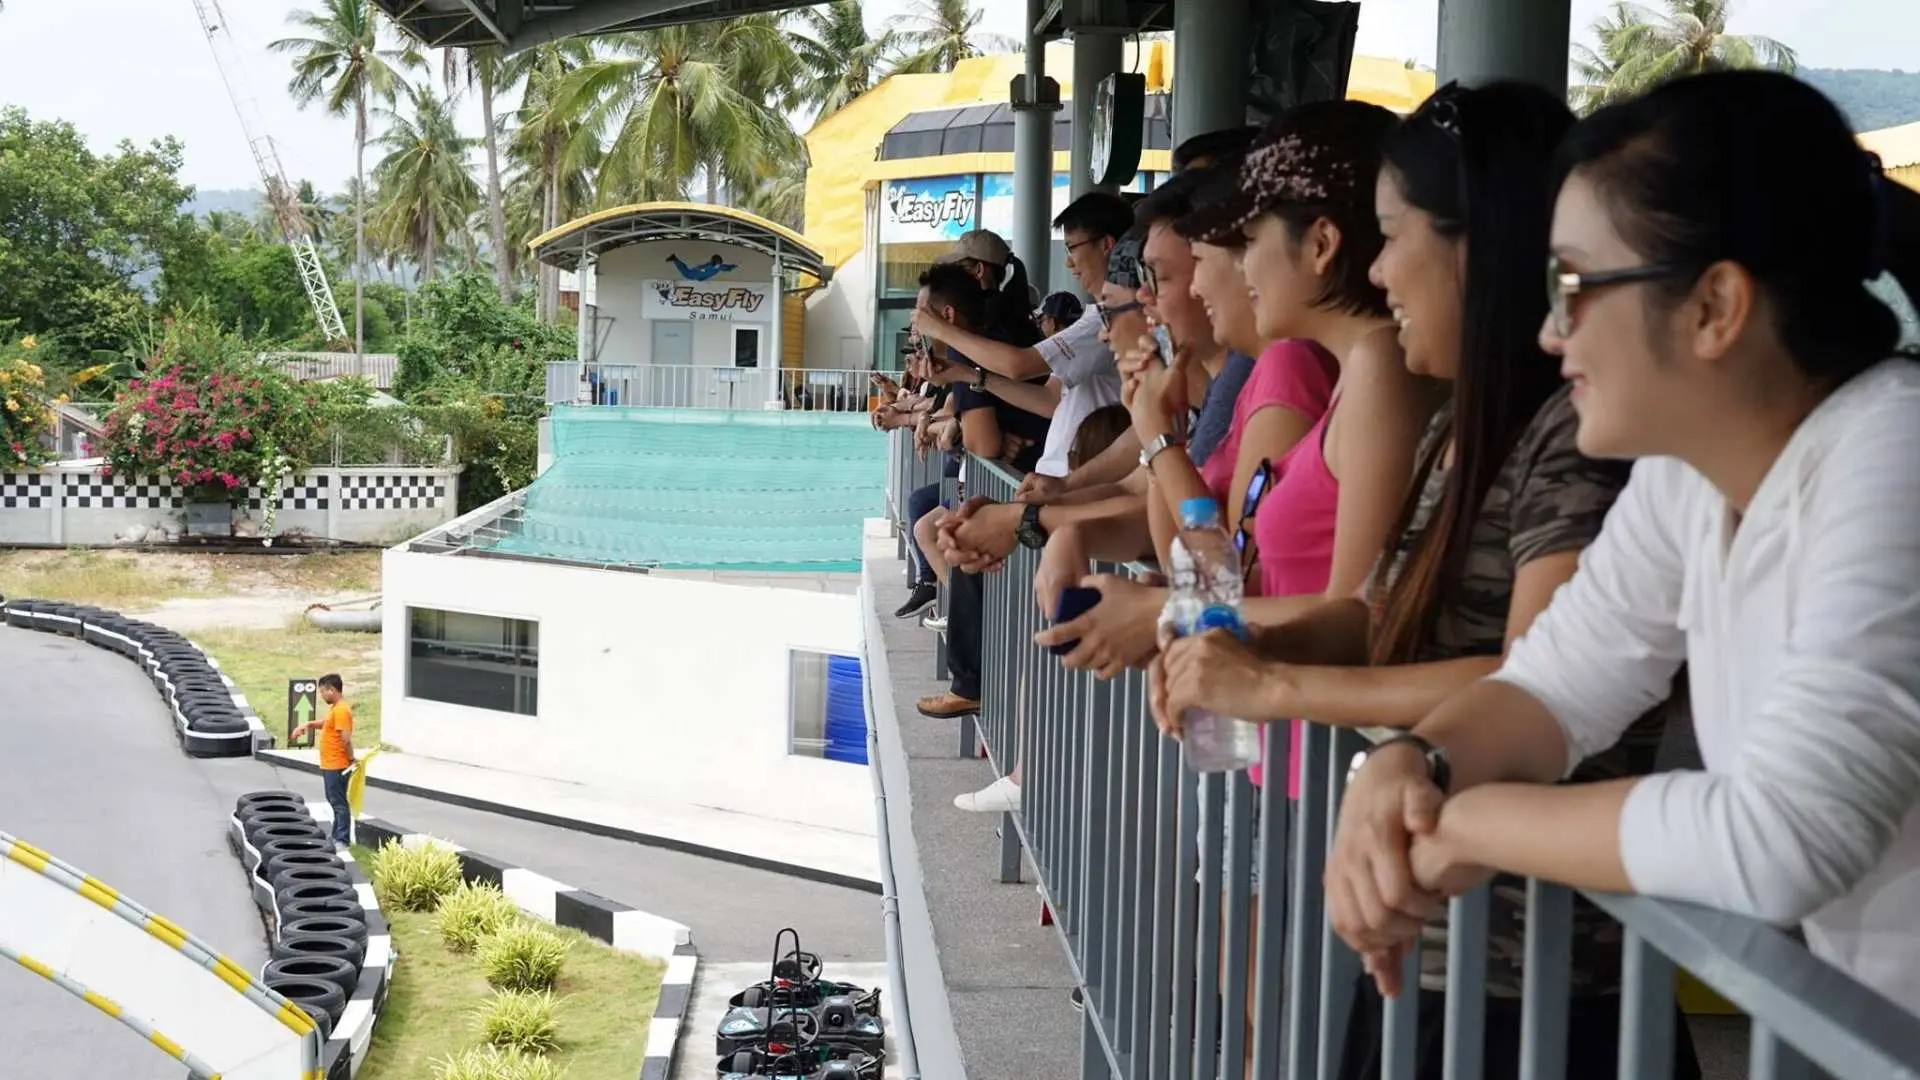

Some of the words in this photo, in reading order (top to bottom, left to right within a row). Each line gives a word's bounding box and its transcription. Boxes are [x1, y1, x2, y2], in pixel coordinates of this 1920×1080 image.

[898, 191, 974, 227] EasyFly
[672, 286, 763, 312] EasyFly
[689, 311, 733, 321] Samui
[294, 682, 316, 693] GO
